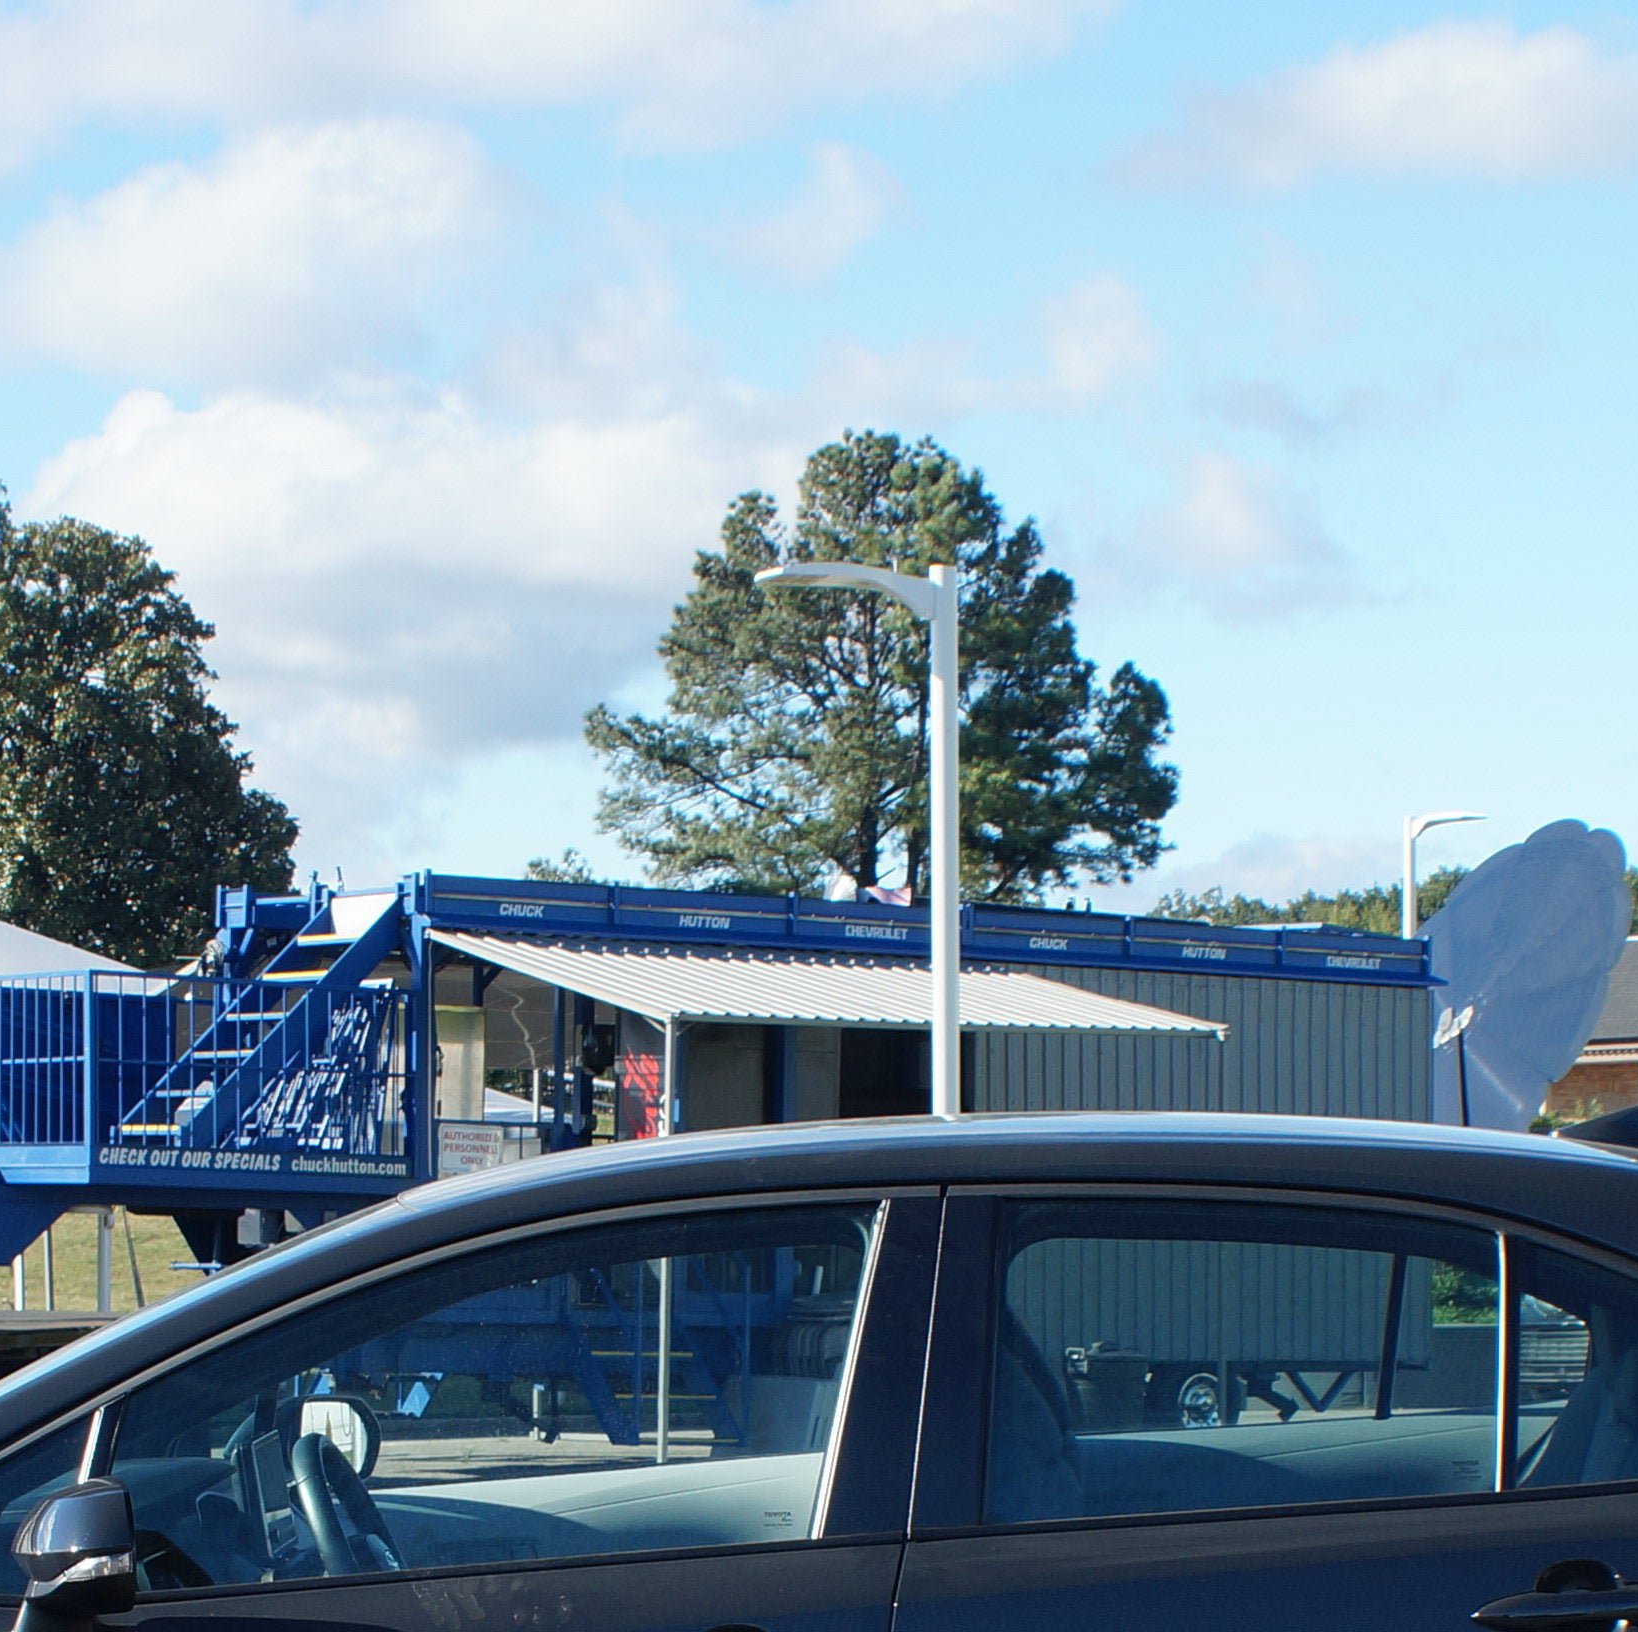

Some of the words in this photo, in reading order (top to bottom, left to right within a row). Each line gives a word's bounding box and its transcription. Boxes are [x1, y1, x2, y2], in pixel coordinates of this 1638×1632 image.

[499, 903, 544, 918] CHUCK
[679, 914, 731, 929] HUTTON
[845, 925, 908, 940] CHEVROLET
[1029, 937, 1068, 950] CHUCK
[1182, 947, 1226, 960] HUTTON
[1327, 955, 1381, 969] CHEVROLET
[99, 1147, 148, 1166] CHECK
[150, 1149, 179, 1167] OUT
[181, 1151, 212, 1168] OUR
[214, 1152, 282, 1171] SPECIALS
[443, 1143, 498, 1154] PERSONNEL
[291, 1155, 406, 1175] chuckhutton.com
[460, 1155, 483, 1165] ONLY
